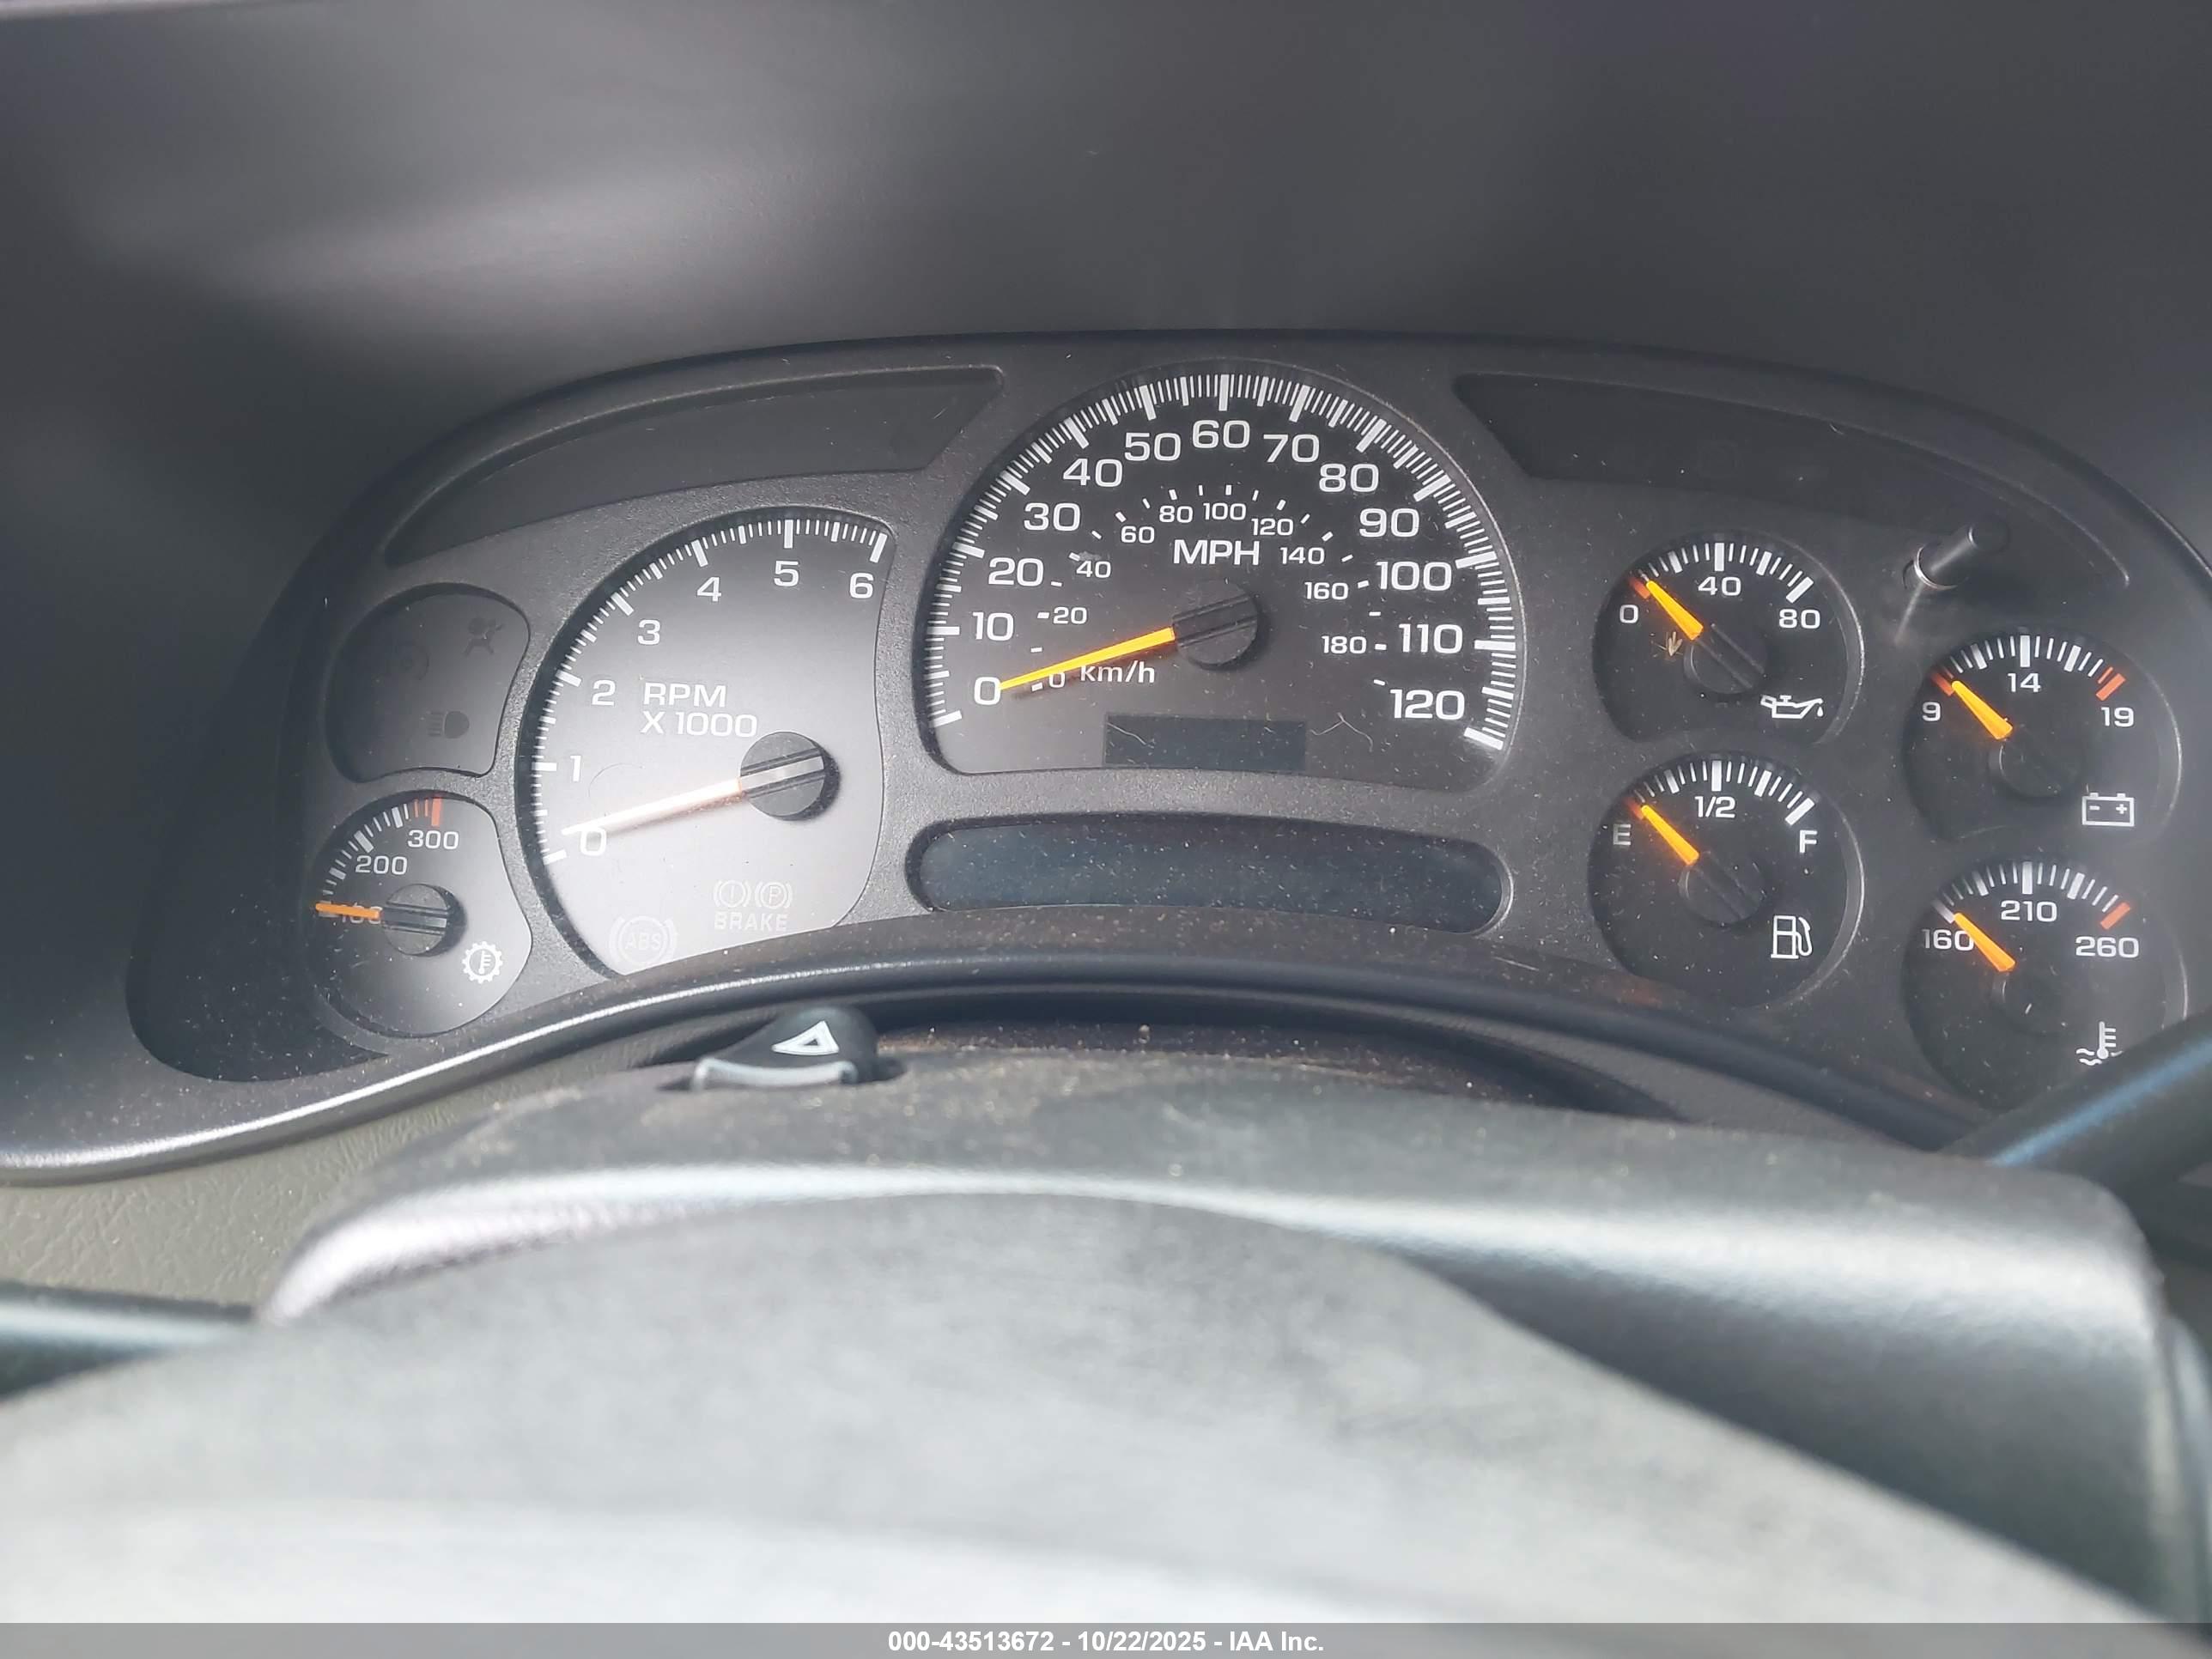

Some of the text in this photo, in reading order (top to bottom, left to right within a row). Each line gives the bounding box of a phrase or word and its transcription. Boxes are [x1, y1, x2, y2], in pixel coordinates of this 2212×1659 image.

[1193, 420, 1249, 448] 60
[1125, 433, 1181, 460] 50
[1264, 434, 1319, 462] 70
[1063, 459, 1122, 487] 40
[1320, 464, 1378, 492] 80
[1024, 503, 1079, 531] 30
[1160, 506, 1193, 523] 80
[1204, 503, 1246, 520] 100
[1360, 508, 1419, 537] 90
[1121, 526, 1154, 543] 60
[1252, 519, 1293, 535] 120
[1174, 540, 1259, 565] MPH
[1280, 547, 1324, 564] 140
[775, 561, 799, 586] 5
[989, 557, 1043, 586] 20
[1077, 561, 1110, 578] 40
[1376, 562, 1451, 591] 100
[697, 577, 721, 601] 4
[850, 573, 873, 598] 6
[1305, 582, 1348, 599] 160
[1698, 577, 1741, 595] 40
[1054, 607, 1086, 623] 20
[1620, 605, 1638, 623] 0
[1779, 609, 1820, 629] 80
[638, 620, 660, 644] 3
[973, 612, 1013, 641] 10
[1322, 636, 1366, 653] 180
[1399, 624, 1462, 653] 110
[1081, 662, 1155, 683] km/h
[2008, 673, 2040, 692] 14
[592, 680, 615, 705] 2
[644, 683, 726, 708] RPM
[974, 678, 1001, 706] 0
[1390, 690, 1464, 720] 120
[1923, 702, 1940, 721] 9
[641, 711, 757, 737] X 1000
[2101, 708, 2133, 726] 19
[570, 756, 580, 781] 1
[1695, 796, 1735, 817] 1/2
[408, 830, 459, 849] 300
[580, 828, 606, 856] 0
[1613, 824, 1631, 845] E
[1800, 830, 1817, 853] F
[356, 856, 407, 874] 200
[714, 911, 788, 932] BRAKE
[2002, 901, 2057, 921] 210
[1922, 929, 1974, 951] 160
[2076, 937, 2138, 957] 260
